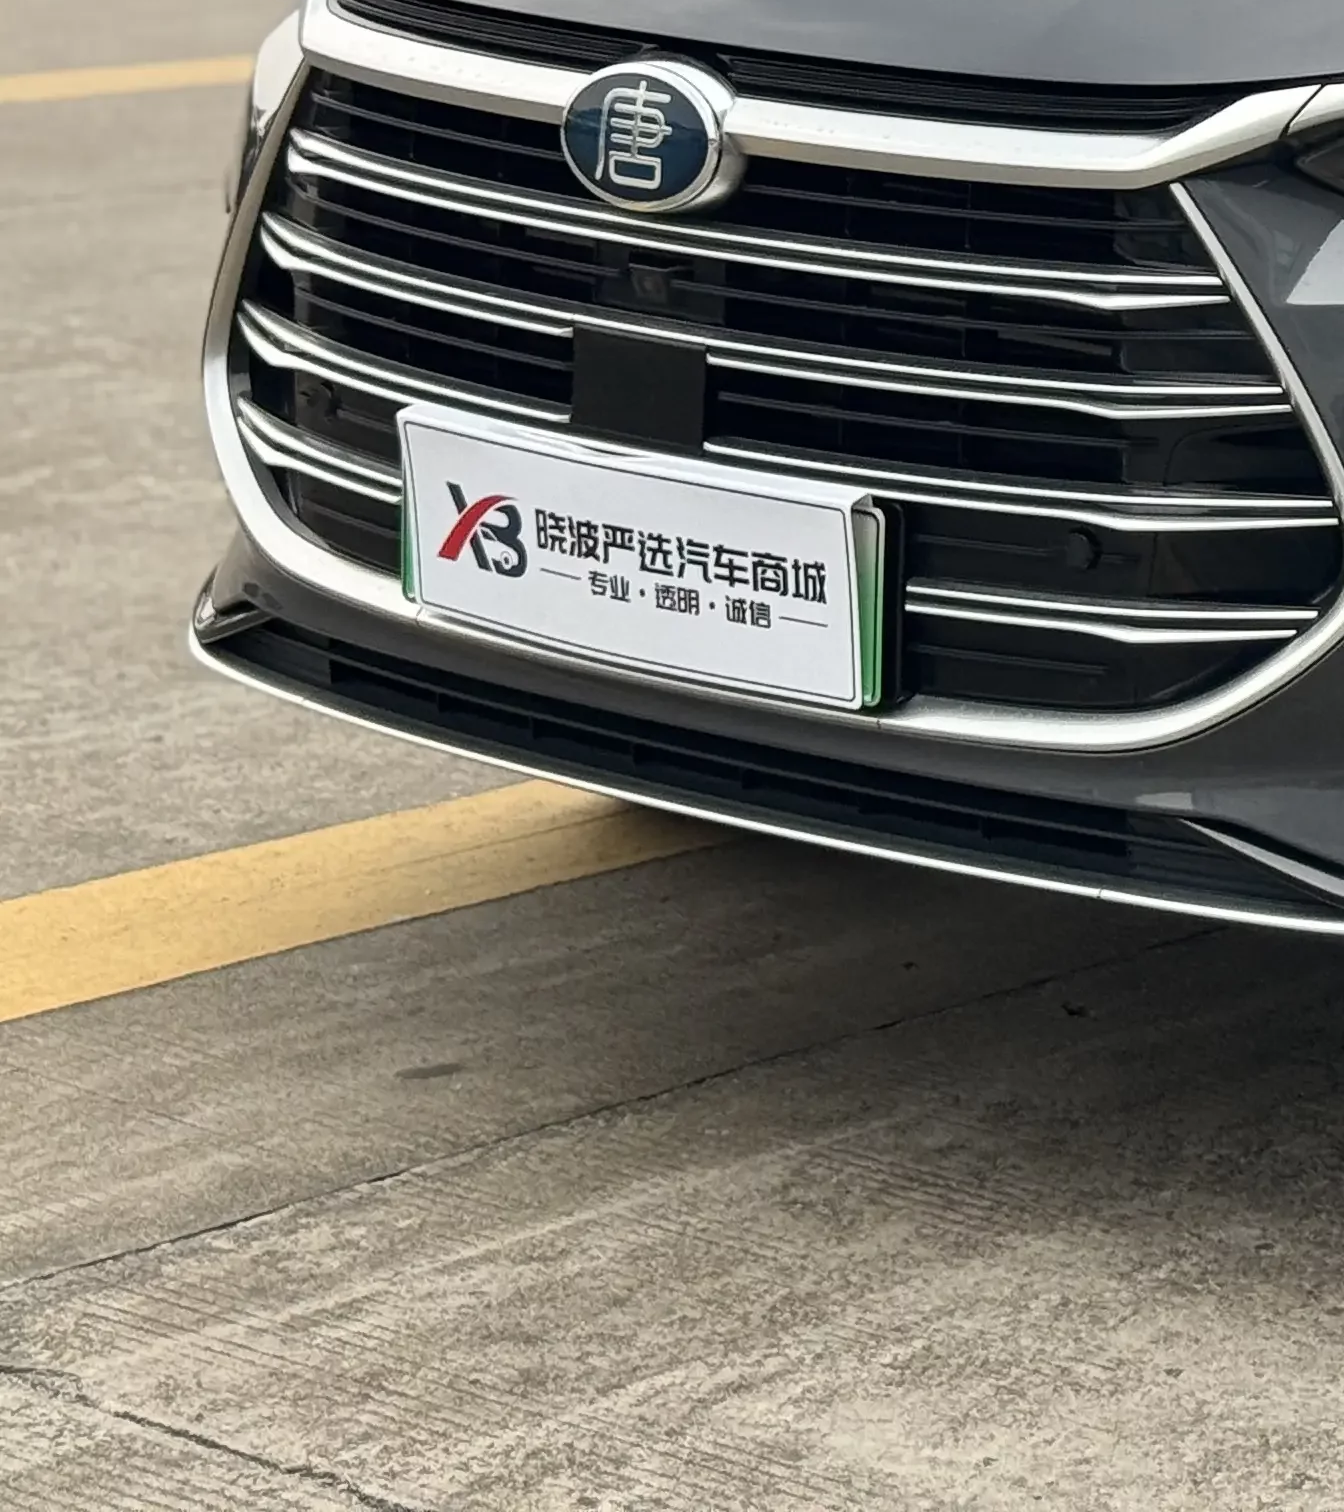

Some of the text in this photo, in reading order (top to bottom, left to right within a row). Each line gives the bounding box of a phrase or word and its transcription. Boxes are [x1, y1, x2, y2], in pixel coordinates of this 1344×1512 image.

[595, 80, 673, 190] 唐
[535, 508, 828, 605] 晓波严选汽车商城
